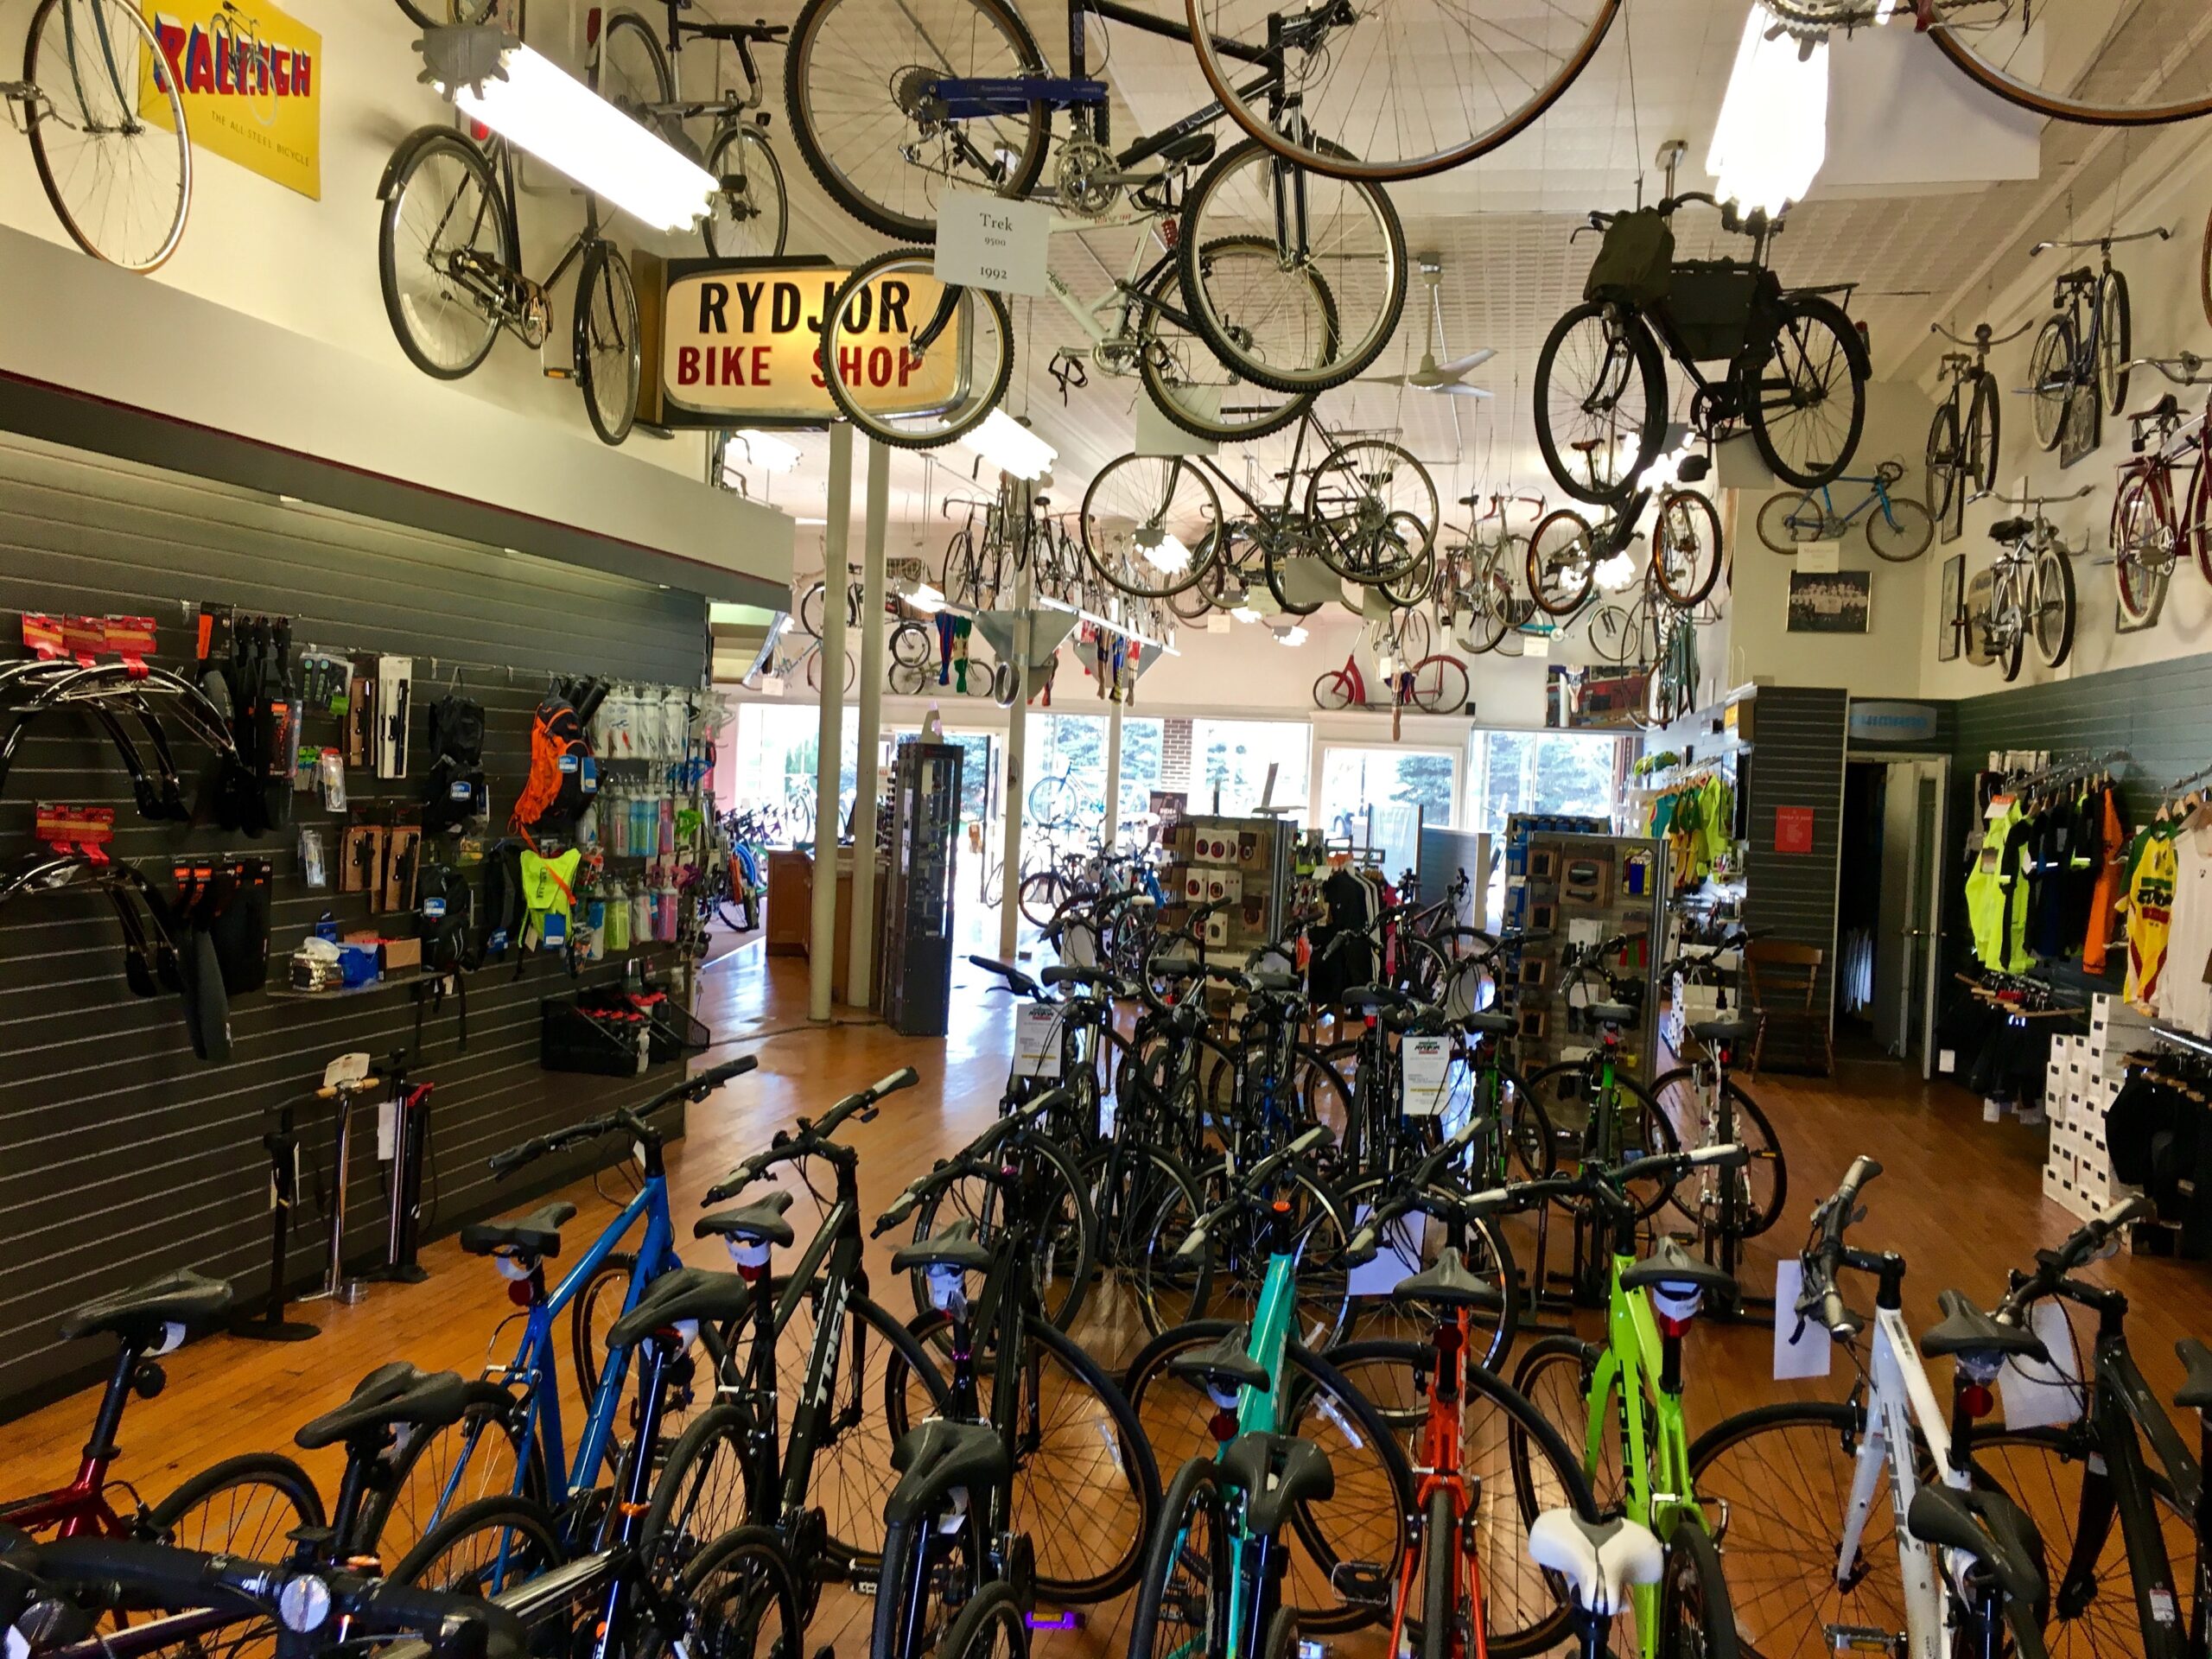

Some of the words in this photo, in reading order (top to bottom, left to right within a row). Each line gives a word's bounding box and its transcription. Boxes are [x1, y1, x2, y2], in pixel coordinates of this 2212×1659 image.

[154, 12, 312, 98] RALEIGH
[211, 110, 226, 127] THE
[276, 143, 310, 168] BICYCLE
[979, 212, 1014, 232] Trek
[984, 237, 1007, 247] 9500
[980, 266, 1008, 281] 1992
[698, 281, 910, 334] RYDJOR
[677, 346, 772, 387] BIKE
[810, 346, 923, 388] SHOP
[812, 1275, 851, 1409] TREK
[1880, 1402, 1911, 1554] TREK
